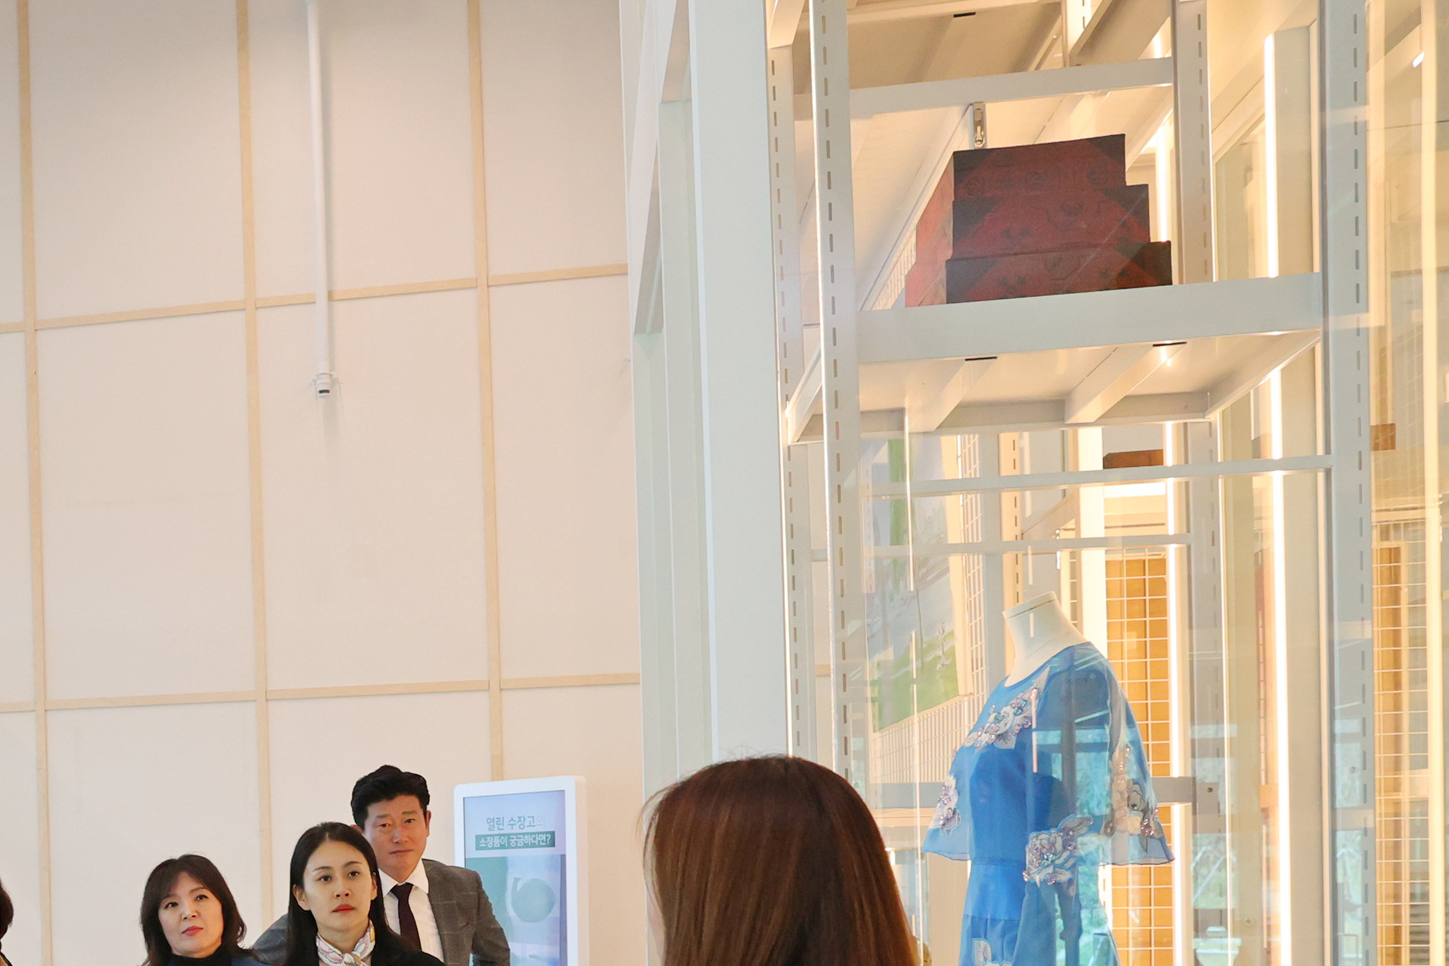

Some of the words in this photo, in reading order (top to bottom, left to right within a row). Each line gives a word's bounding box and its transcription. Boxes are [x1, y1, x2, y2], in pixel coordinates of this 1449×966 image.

[486, 816, 504, 831] 열린
[479, 835, 508, 848] 소장품이
[510, 833, 551, 847] 궁금하다면?
